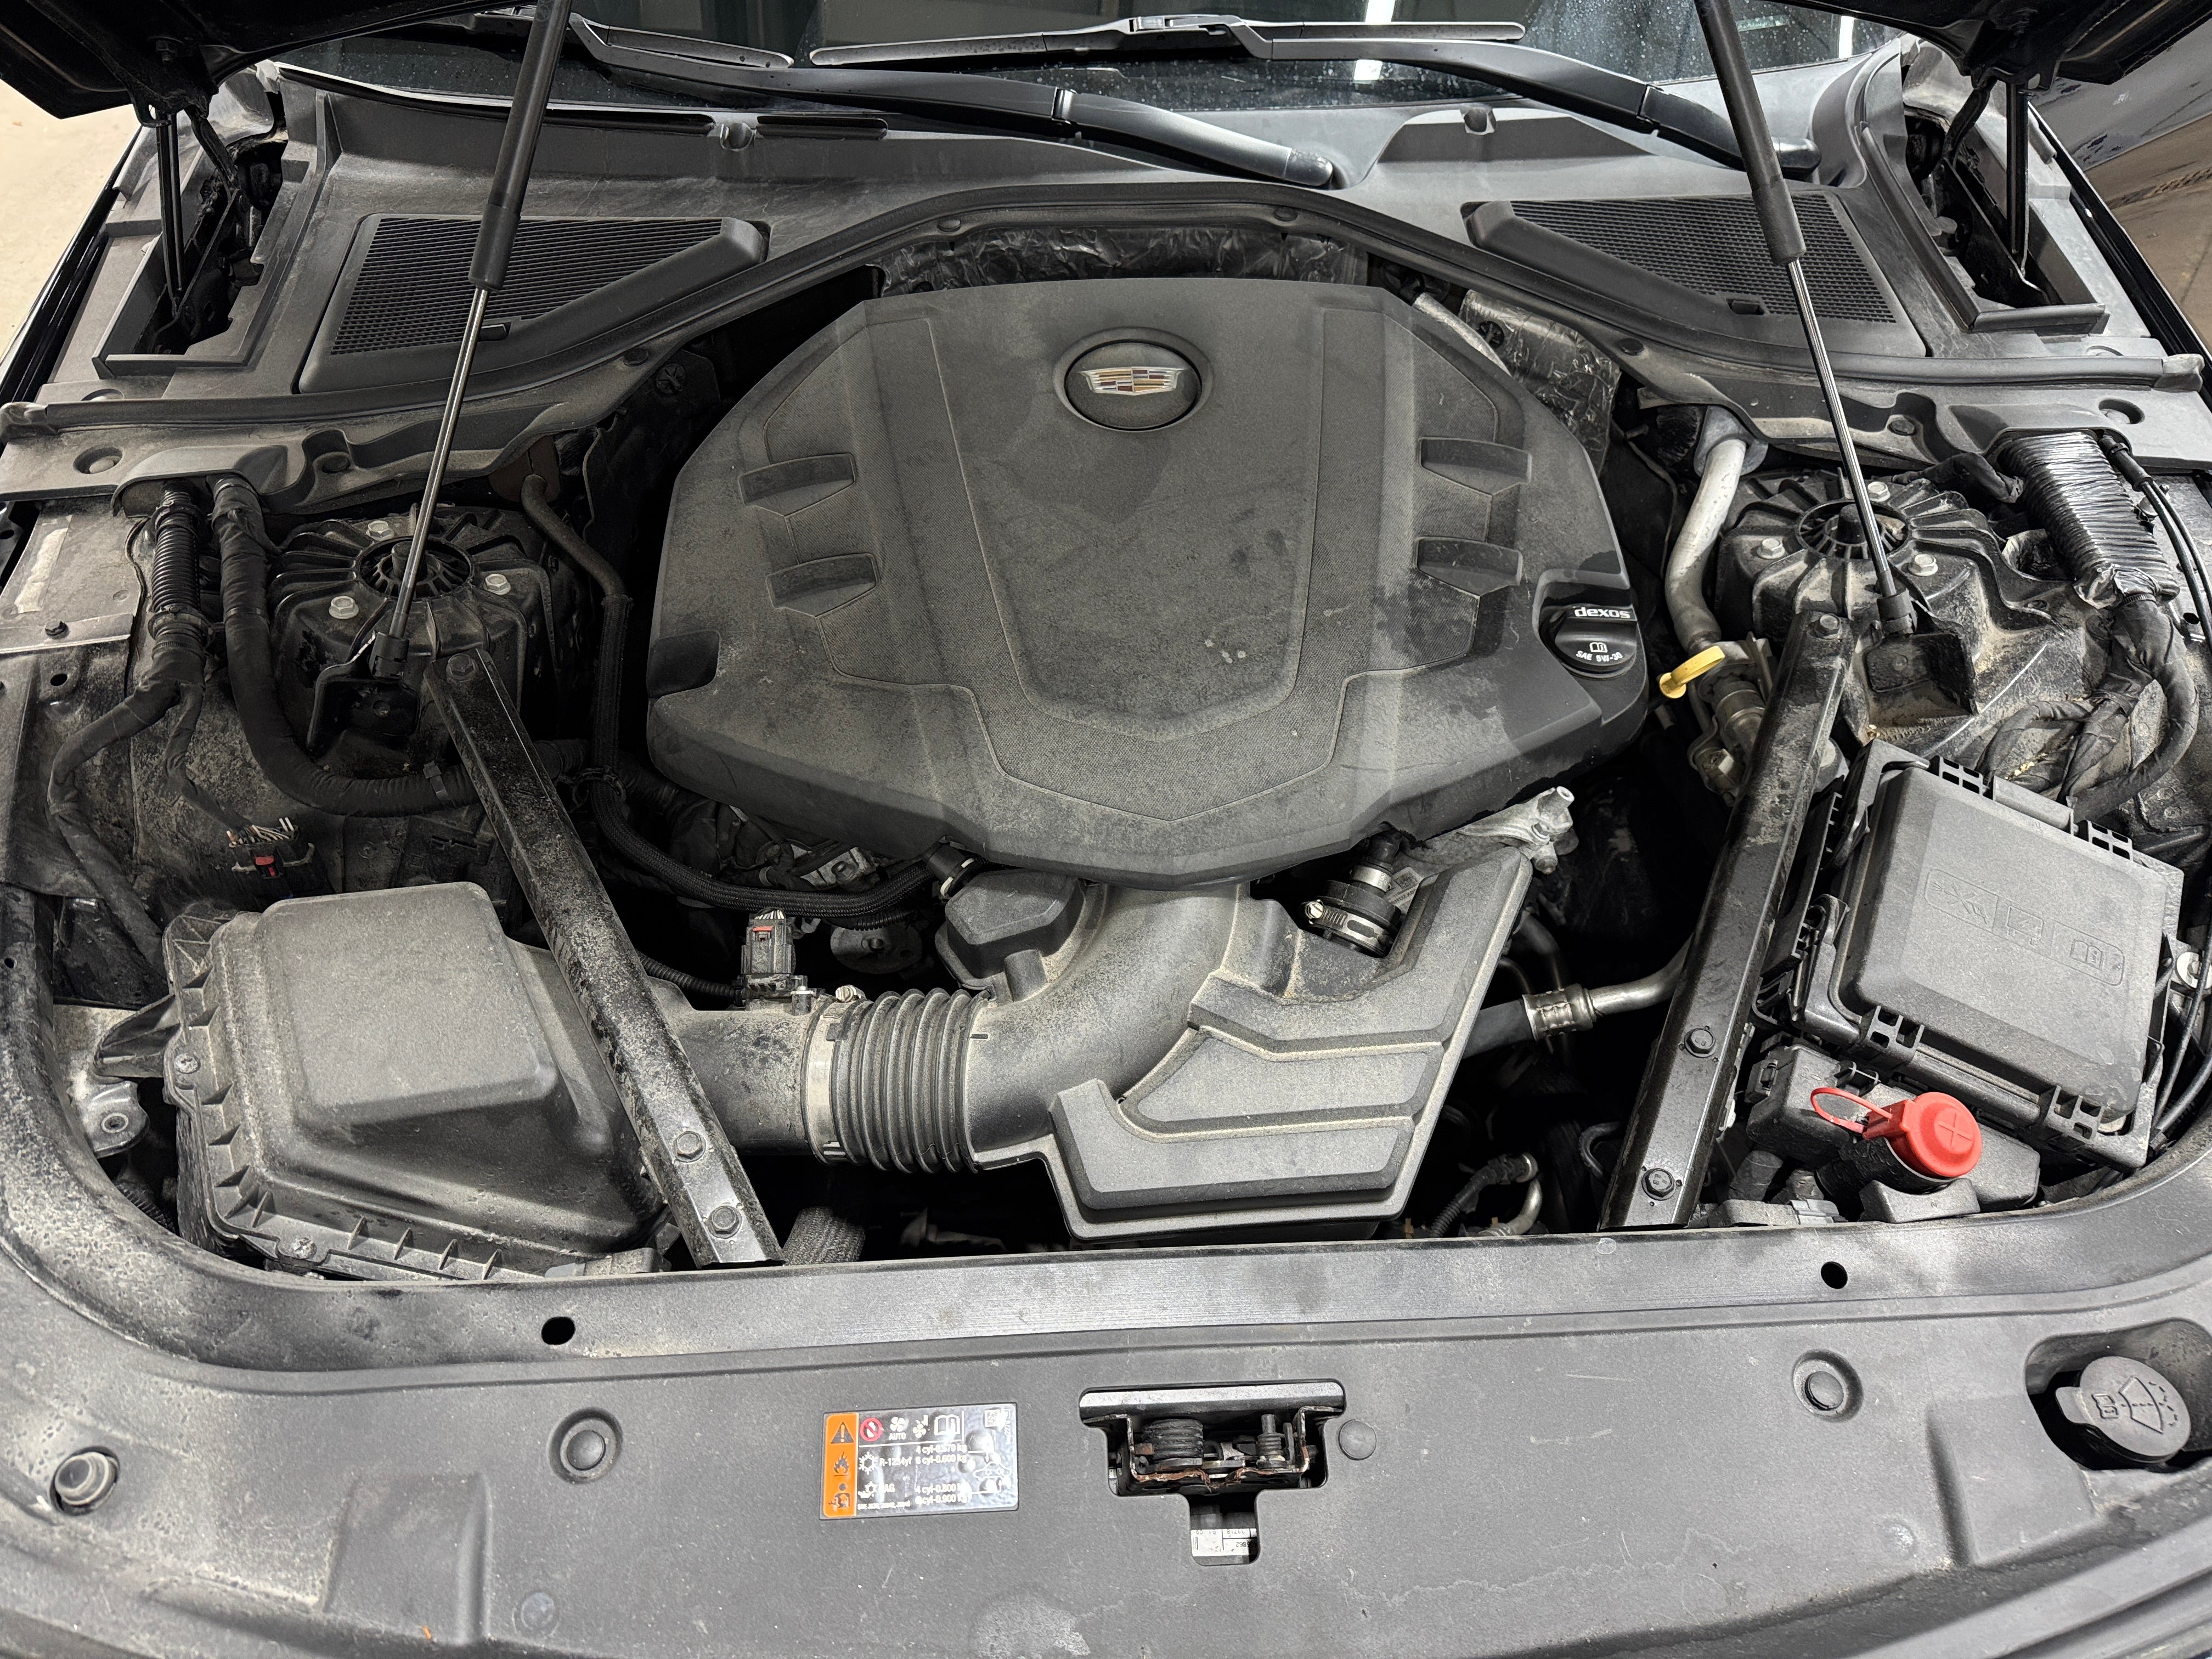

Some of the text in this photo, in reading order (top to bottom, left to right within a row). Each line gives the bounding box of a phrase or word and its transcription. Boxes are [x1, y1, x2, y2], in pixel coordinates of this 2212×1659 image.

[1574, 607, 1630, 619] dexos
[1576, 650, 1623, 662] SAE 5W-30
[889, 1432, 906, 1440] AUTO
[915, 1446, 921, 1454] 4
[957, 1443, 967, 1453] kg
[915, 1456, 921, 1464] 6
[957, 1453, 967, 1464] kg
